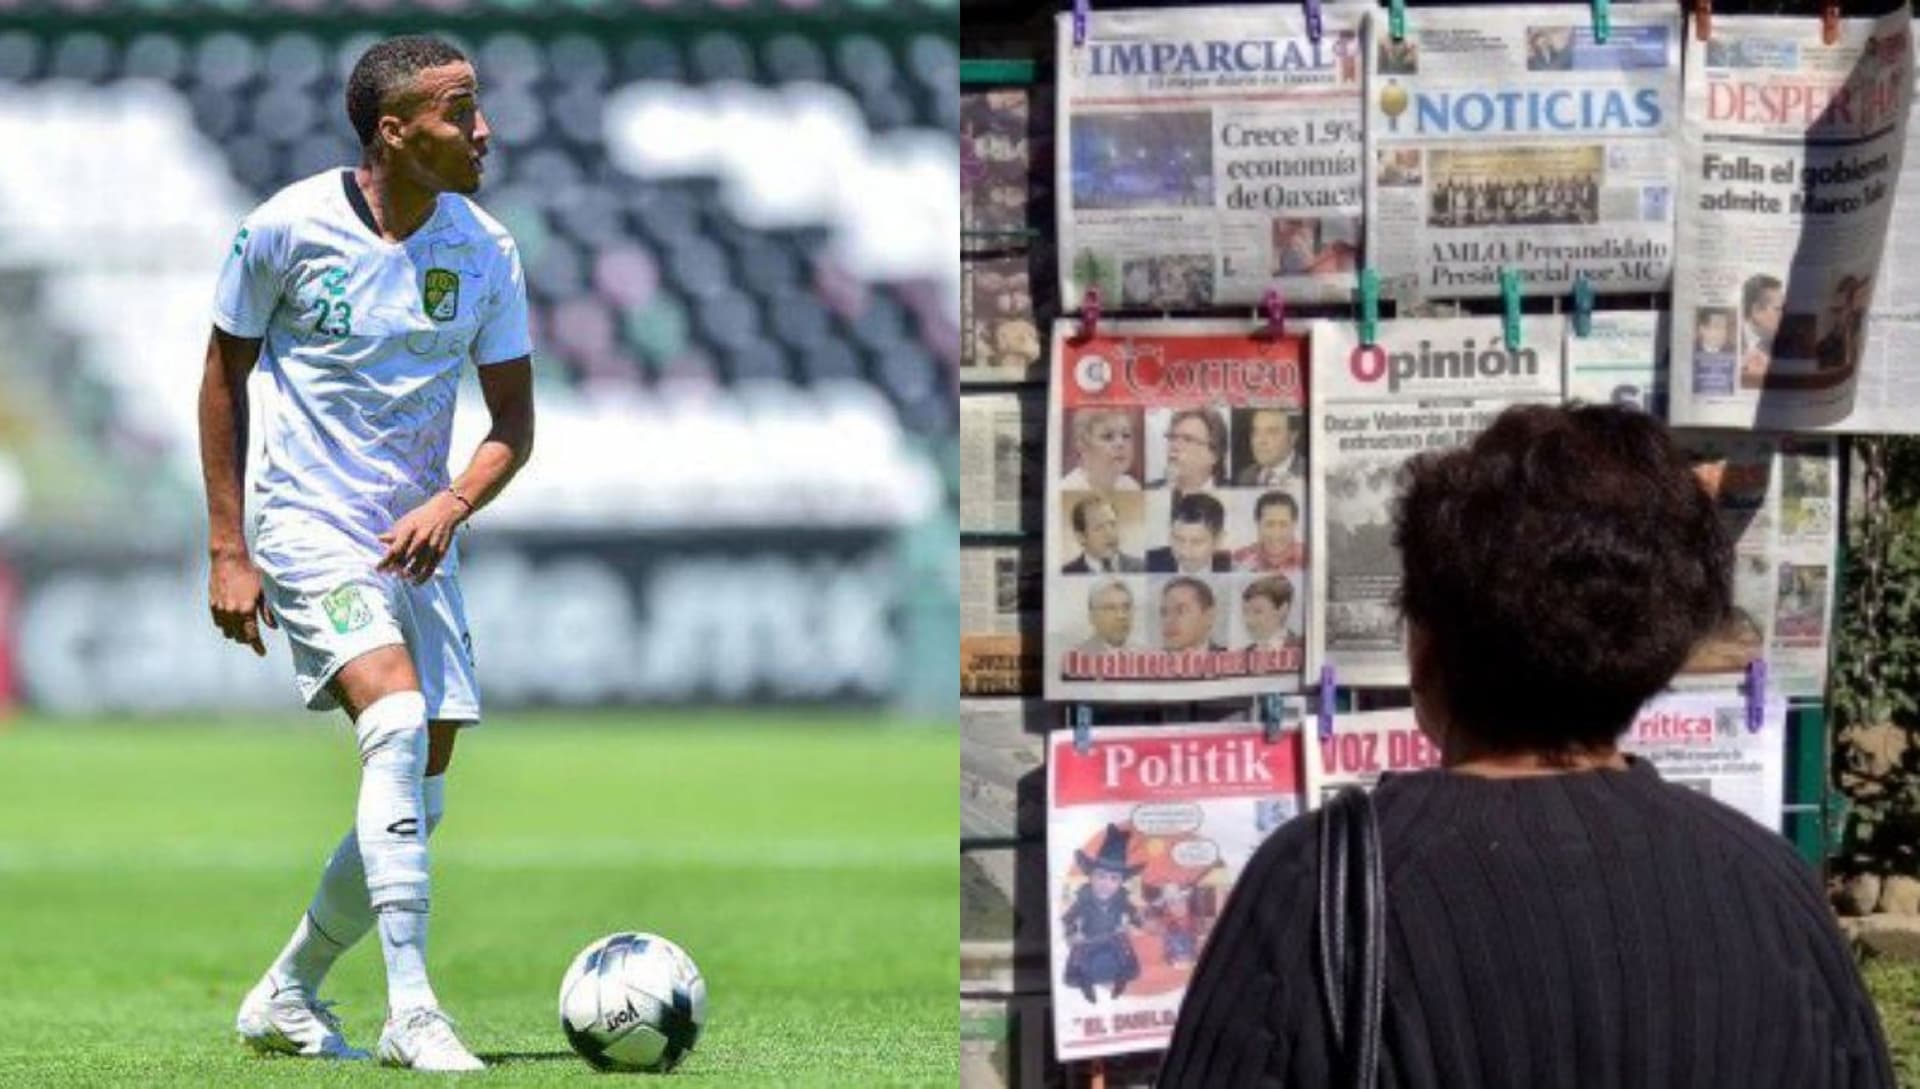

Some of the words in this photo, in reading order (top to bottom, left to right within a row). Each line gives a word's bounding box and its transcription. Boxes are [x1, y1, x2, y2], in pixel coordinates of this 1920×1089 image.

[1089, 39, 1334, 75] IMPARCIAL
[1415, 89, 1662, 133] NOTICIAS
[1221, 121, 1299, 148] Crece
[1226, 148, 1356, 180] economía
[1702, 153, 1764, 183] Falla
[1771, 158, 1795, 184] el
[1226, 182, 1258, 210] de
[1700, 186, 1782, 215] admite
[1516, 237, 1667, 261] Precandidato
[313, 298, 352, 340] 23
[1124, 344, 1298, 395] Correo
[1350, 336, 1539, 394] Opinión
[1638, 712, 1712, 738] rítica
[1103, 738, 1274, 789] Politik
[1321, 733, 1381, 774] VOZ
